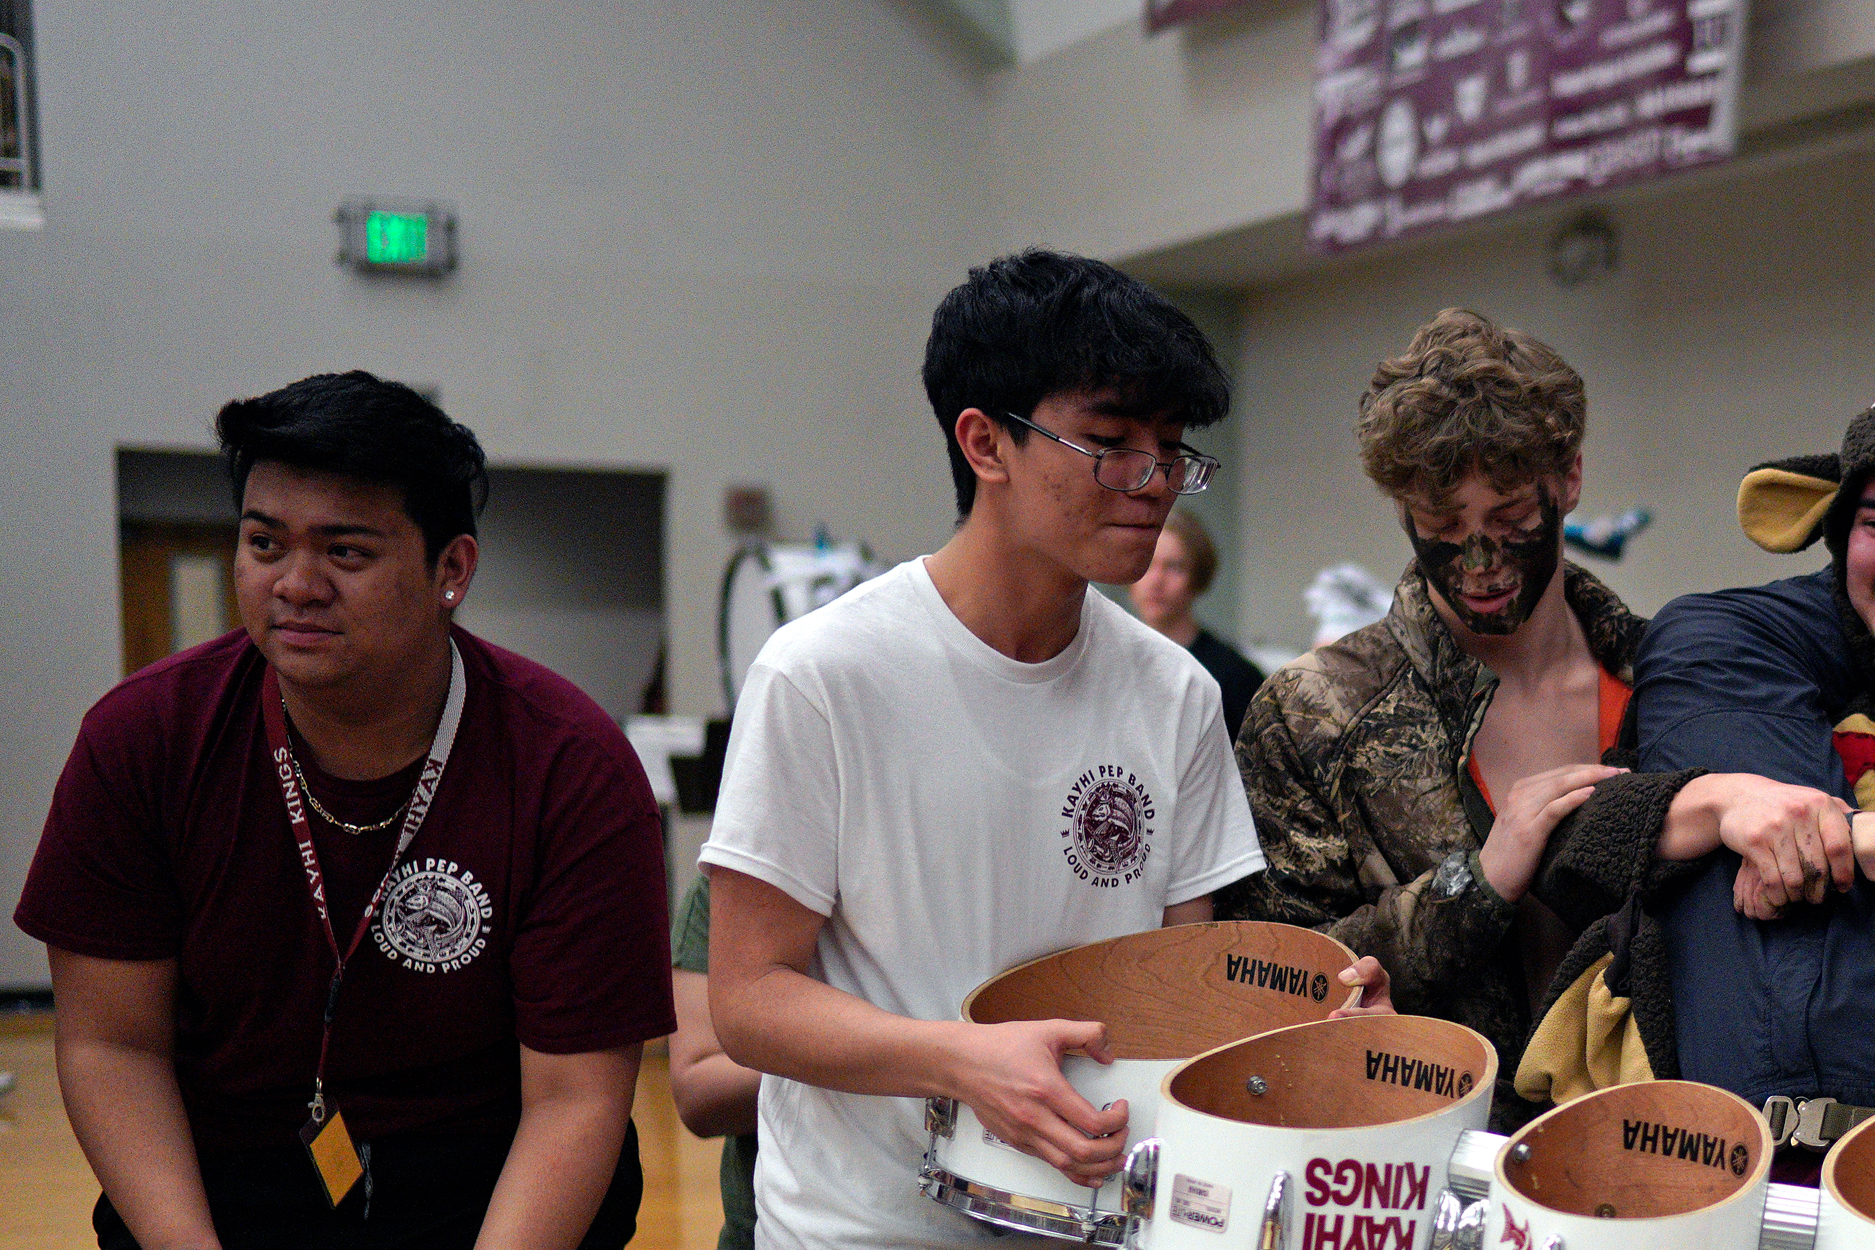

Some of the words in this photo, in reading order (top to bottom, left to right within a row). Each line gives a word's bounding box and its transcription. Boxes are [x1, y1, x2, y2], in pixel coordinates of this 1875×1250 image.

[274, 747, 305, 825] KINGS
[404, 758, 443, 836] KAYHI
[1061, 770, 1095, 818] KAYHI
[1098, 765, 1123, 778] PEP
[1128, 773, 1155, 819] BAND
[425, 857, 458, 875] PEP
[460, 870, 493, 919] BAND
[1063, 846, 1088, 880] LOUD
[1091, 877, 1119, 888] AND
[1124, 844, 1151, 884] PROUD
[371, 925, 398, 960] LOUD
[402, 958, 436, 974] AND
[441, 938, 486, 974] PROUD
[1226, 953, 1309, 998] YAMAHA
[1366, 1049, 1456, 1099] YAMAHA
[1622, 1119, 1728, 1171] YAMAHA
[1304, 1157, 1431, 1211] KINGS
